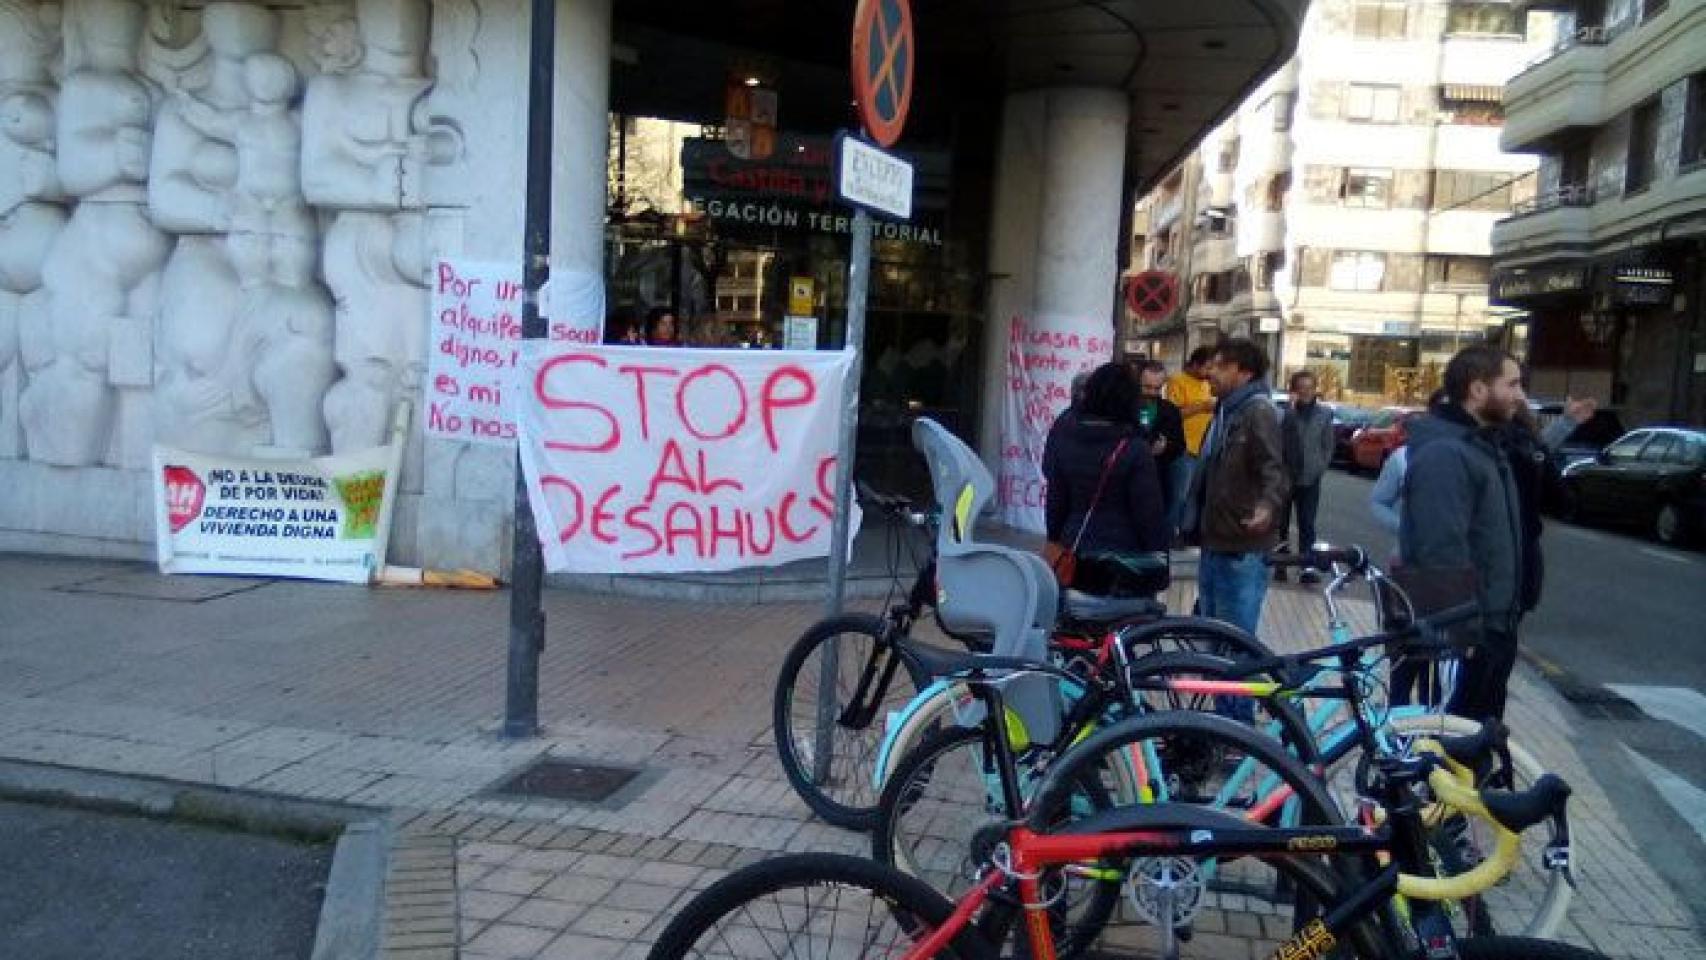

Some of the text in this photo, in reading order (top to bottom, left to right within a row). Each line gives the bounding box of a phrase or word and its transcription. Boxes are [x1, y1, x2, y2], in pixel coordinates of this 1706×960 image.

[692, 197, 943, 246] EGACIÓN TERTORIAL
[438, 261, 481, 297] Por
[468, 379, 501, 405] mi
[534, 352, 818, 453] STOP
[239, 470, 249, 483] A
[254, 470, 274, 484] LA
[645, 438, 744, 503] AL
[220, 487, 240, 500] DE
[245, 487, 277, 501] POR
[202, 506, 285, 521] DERECHO
[289, 508, 300, 522] A
[303, 509, 339, 523] UNA
[200, 523, 335, 540] VIVIENDA DIGNA
